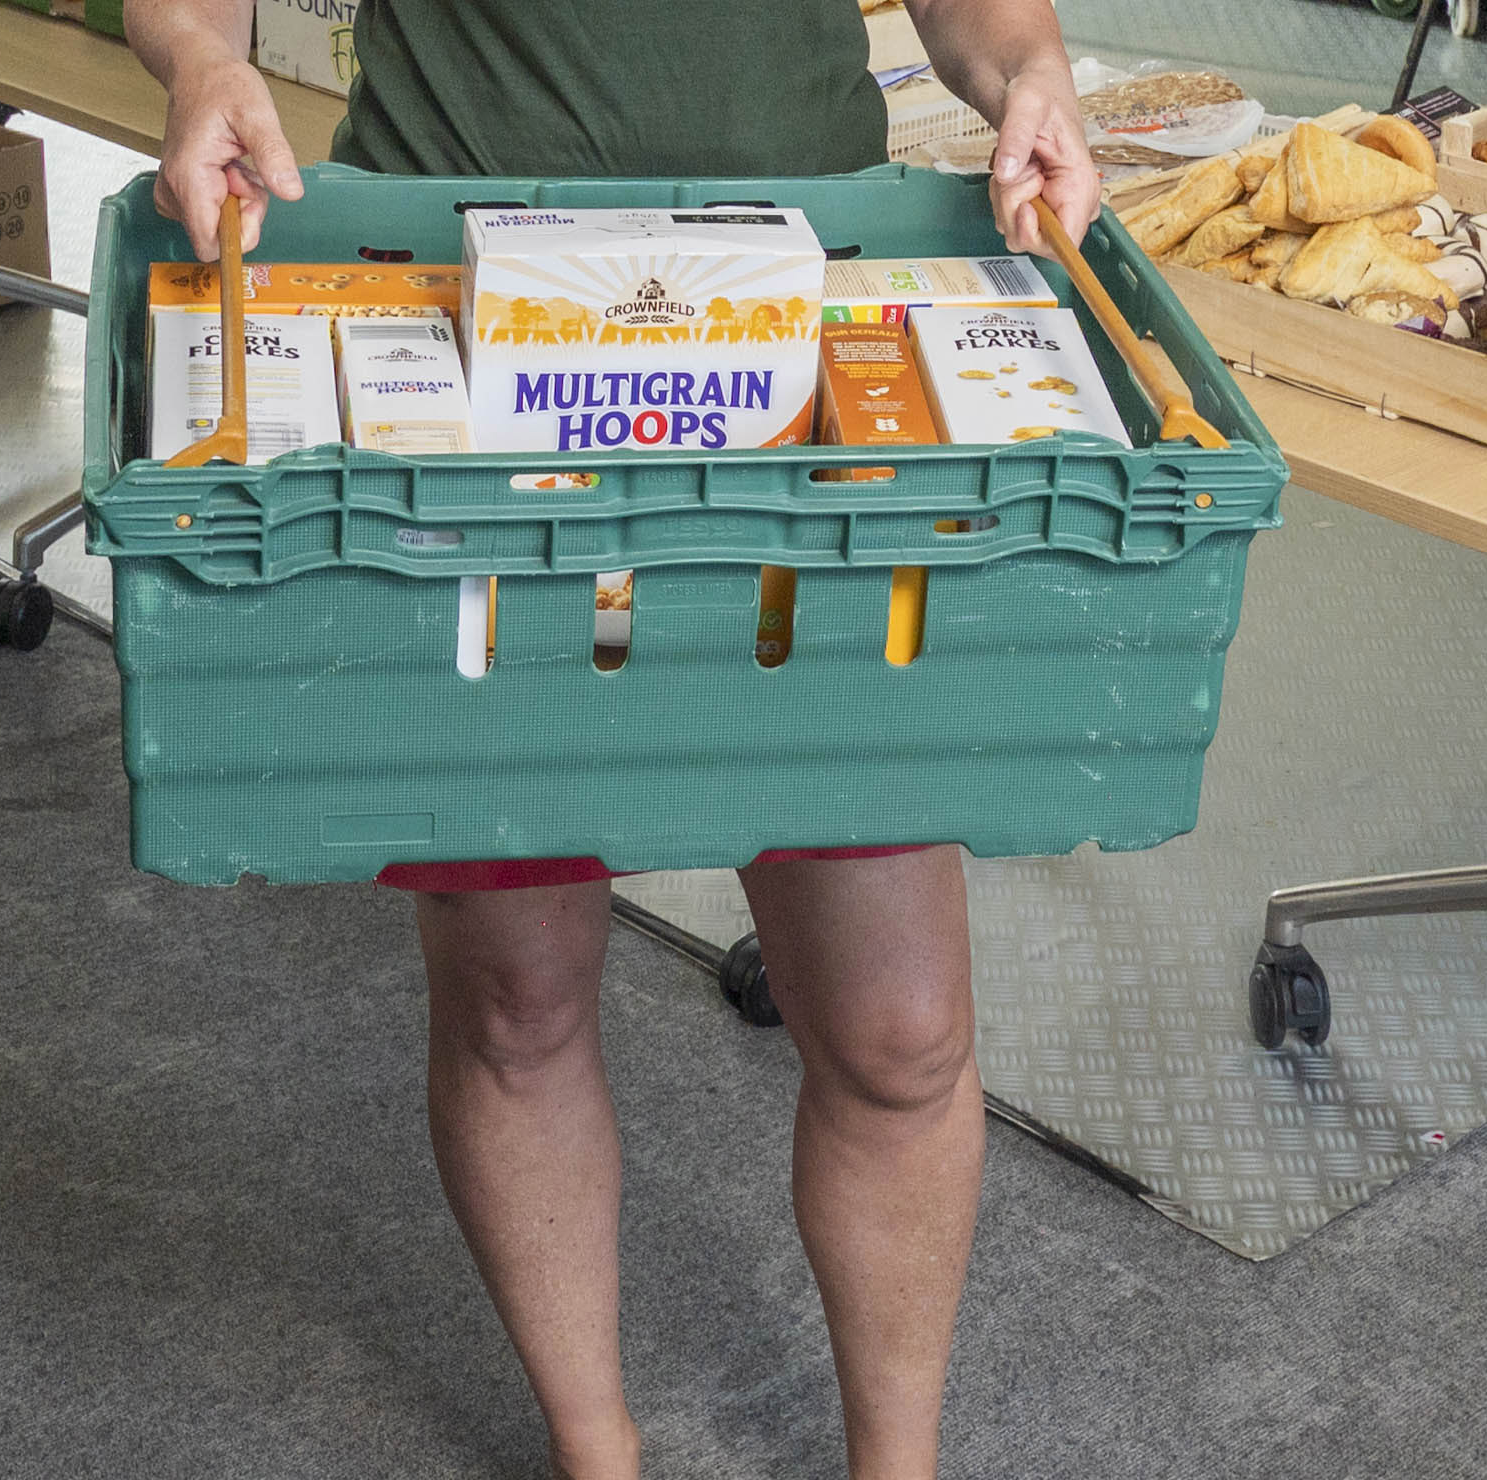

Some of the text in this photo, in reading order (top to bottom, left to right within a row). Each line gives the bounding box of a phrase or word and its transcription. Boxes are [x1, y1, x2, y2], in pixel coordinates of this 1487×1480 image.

[485, 218, 576, 228] MULTIGRAIN
[499, 214, 558, 222] HOOPS
[605, 300, 695, 318] CROWNFIELD
[966, 328, 1039, 339] CORN
[204, 334, 280, 346] CRN
[954, 338, 1062, 351] FLAKES
[189, 345, 300, 359] FLKES
[360, 380, 453, 389] MULTIGRAIN
[377, 386, 439, 394] HOOPS
[513, 370, 774, 414] MULTIGRAIN
[557, 410, 728, 452] HOOPS
[662, 516, 746, 537] TESCO
